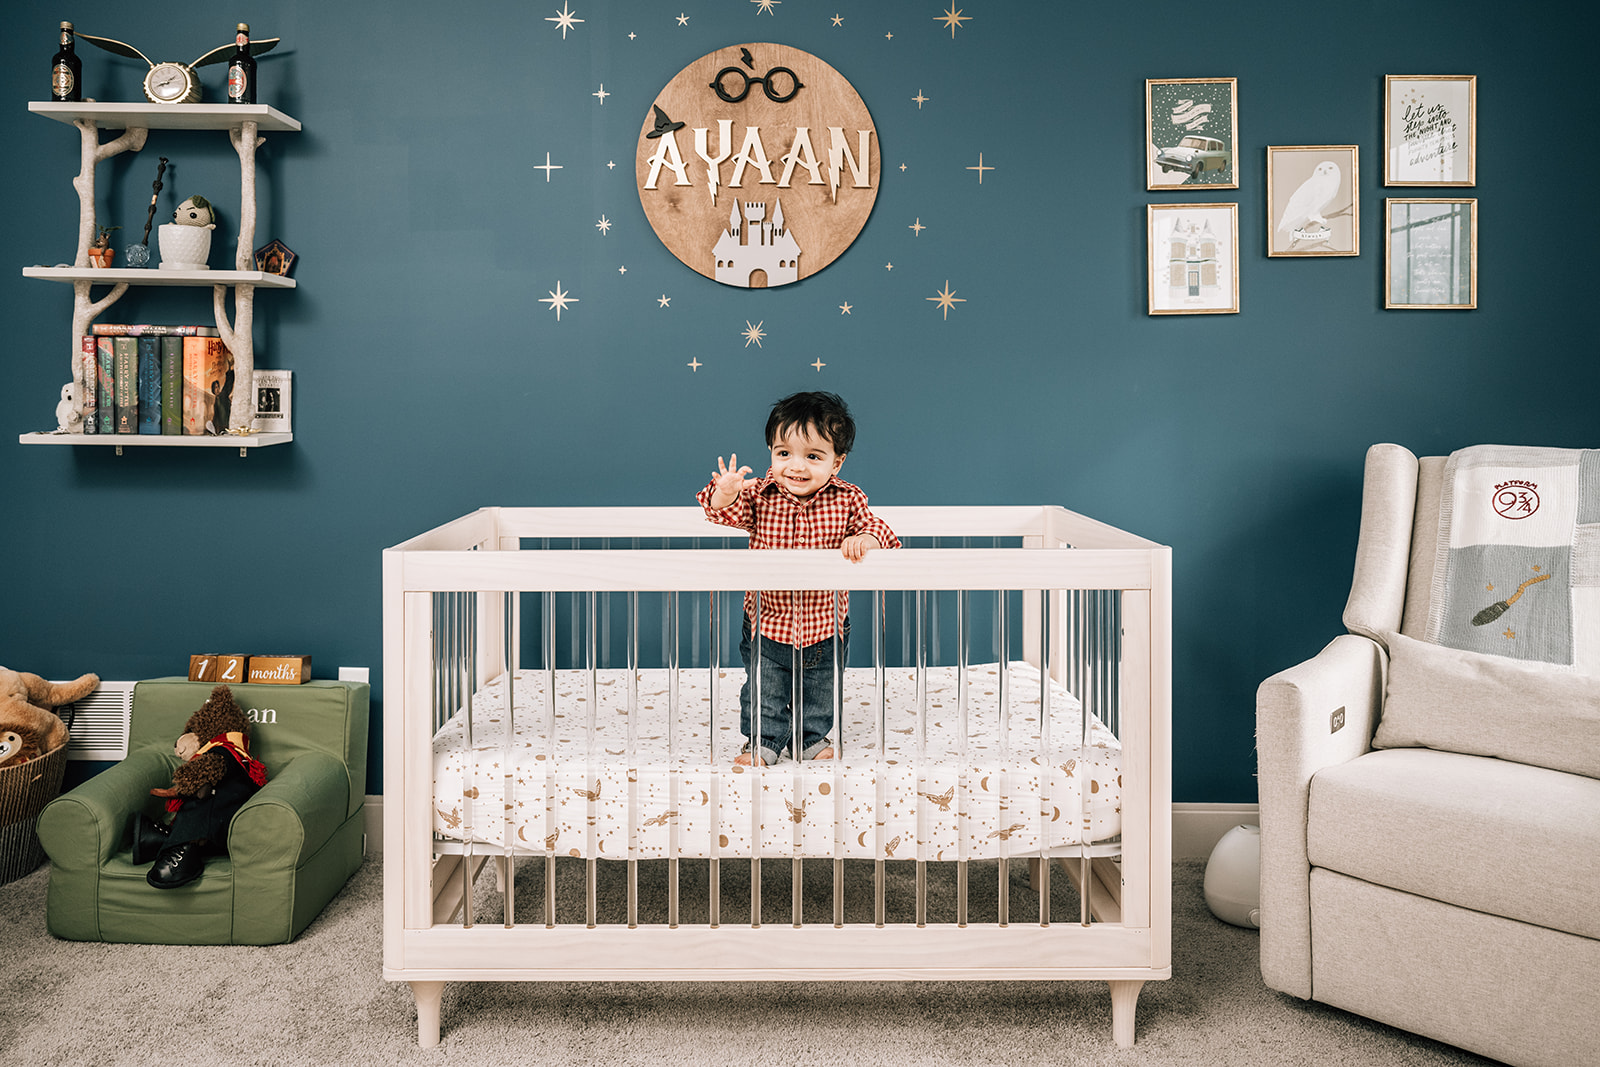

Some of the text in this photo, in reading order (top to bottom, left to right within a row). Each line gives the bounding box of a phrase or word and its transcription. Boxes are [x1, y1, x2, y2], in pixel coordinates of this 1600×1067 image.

[1402, 103, 1444, 122] let us
[1403, 109, 1449, 133] step into
[1404, 131, 1417, 141] THE
[1419, 122, 1439, 135] NIGHT
[643, 119, 873, 206] AYAAN
[1410, 142, 1458, 166] adventure
[1494, 480, 1538, 490] PLATFORM
[198, 659, 298, 681] 1 2 months
